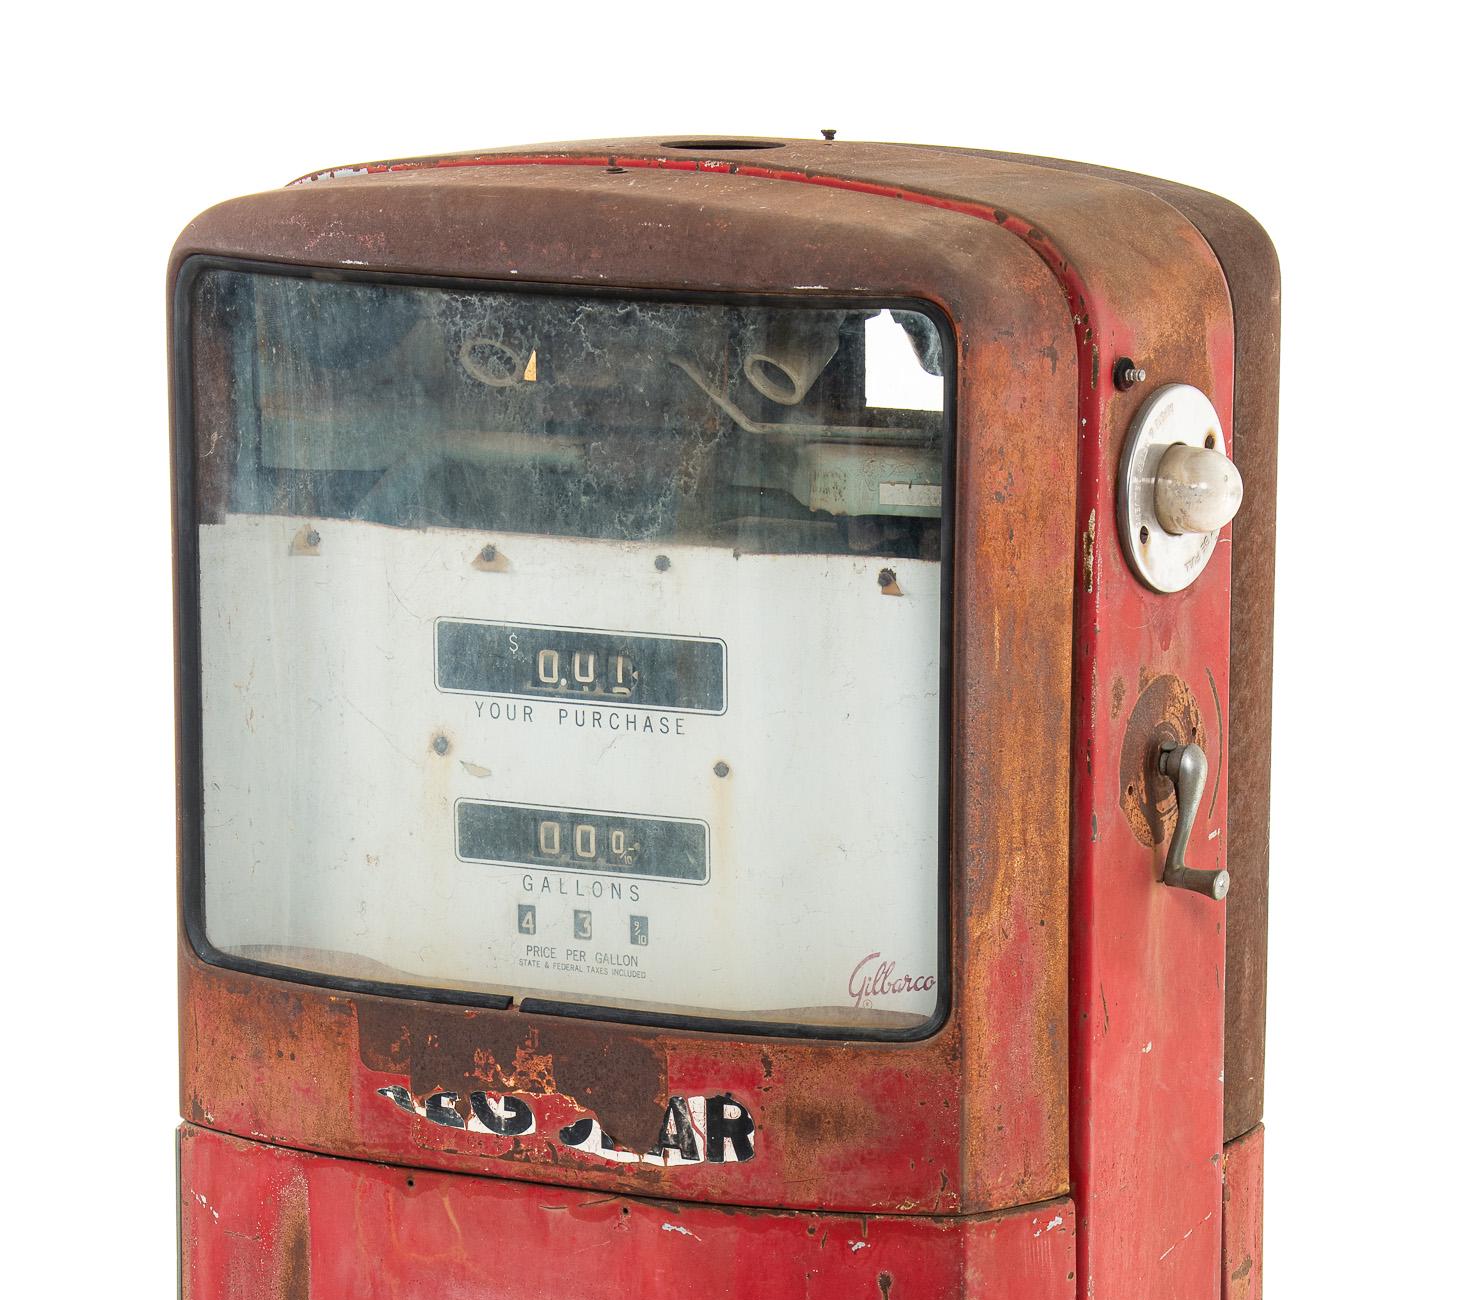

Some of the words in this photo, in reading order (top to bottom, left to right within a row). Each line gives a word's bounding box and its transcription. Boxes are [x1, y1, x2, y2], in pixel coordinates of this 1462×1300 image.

[475, 701, 534, 723] YOUR
[559, 708, 686, 735] PURCHASE
[523, 874, 640, 902] GALLONS
[521, 911, 534, 935] 4
[519, 958, 541, 968] STATE
[553, 962, 583, 973] FEDERAL
[586, 965, 609, 976] TAXES
[612, 968, 647, 979] INCLUDED
[526, 945, 557, 959] PRICE
[566, 949, 586, 962] PER
[595, 952, 639, 967] GALLON
[848, 951, 937, 1009] Gilbarco
